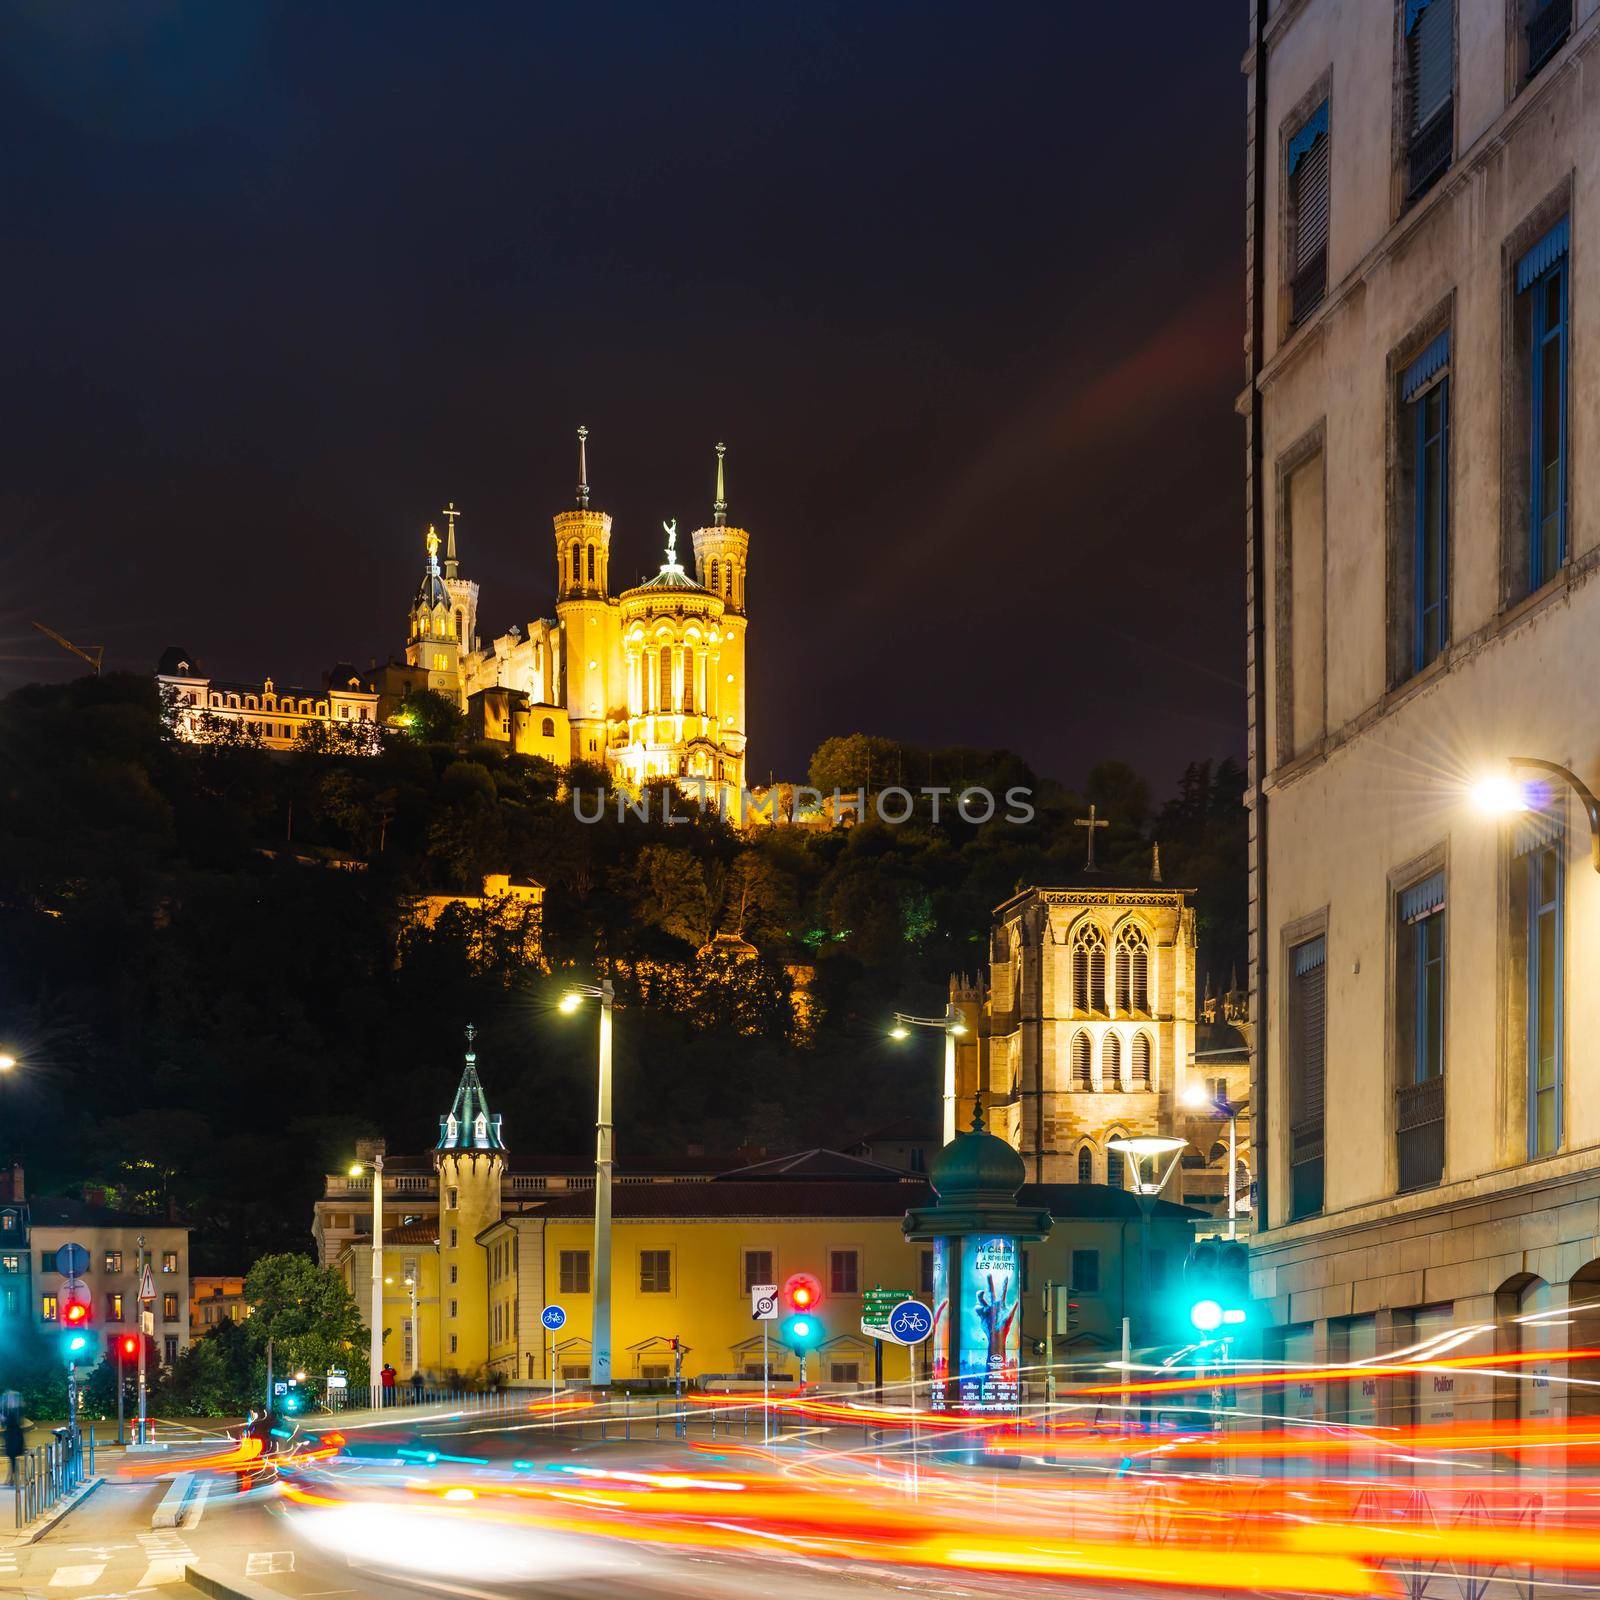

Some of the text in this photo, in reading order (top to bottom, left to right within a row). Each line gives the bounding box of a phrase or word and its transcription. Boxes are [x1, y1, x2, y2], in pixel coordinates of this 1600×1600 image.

[975, 1262, 1015, 1270] LES MORTS
[760, 1302, 770, 1310] 30
